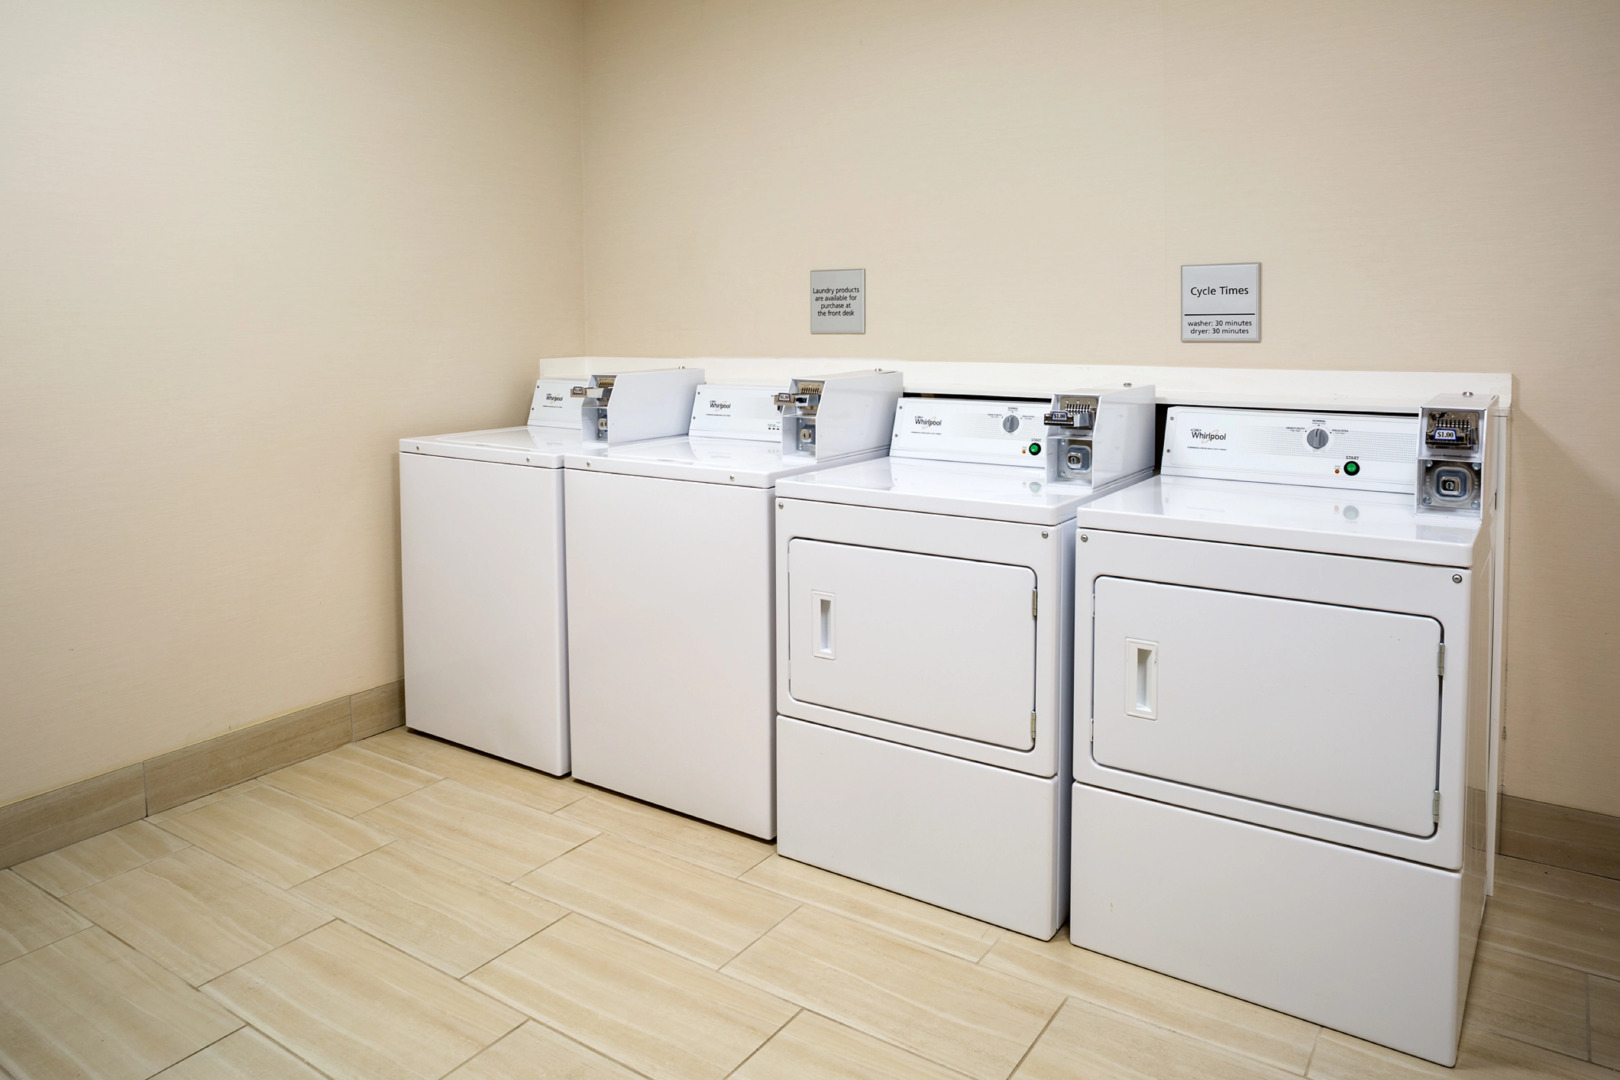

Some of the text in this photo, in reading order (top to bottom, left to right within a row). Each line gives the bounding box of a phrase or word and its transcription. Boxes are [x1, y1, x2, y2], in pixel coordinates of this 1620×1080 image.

[1190, 285, 1249, 298] Cycle Times
[914, 418, 942, 427] Whirlpool
[1192, 432, 1226, 441] Whirlpool
